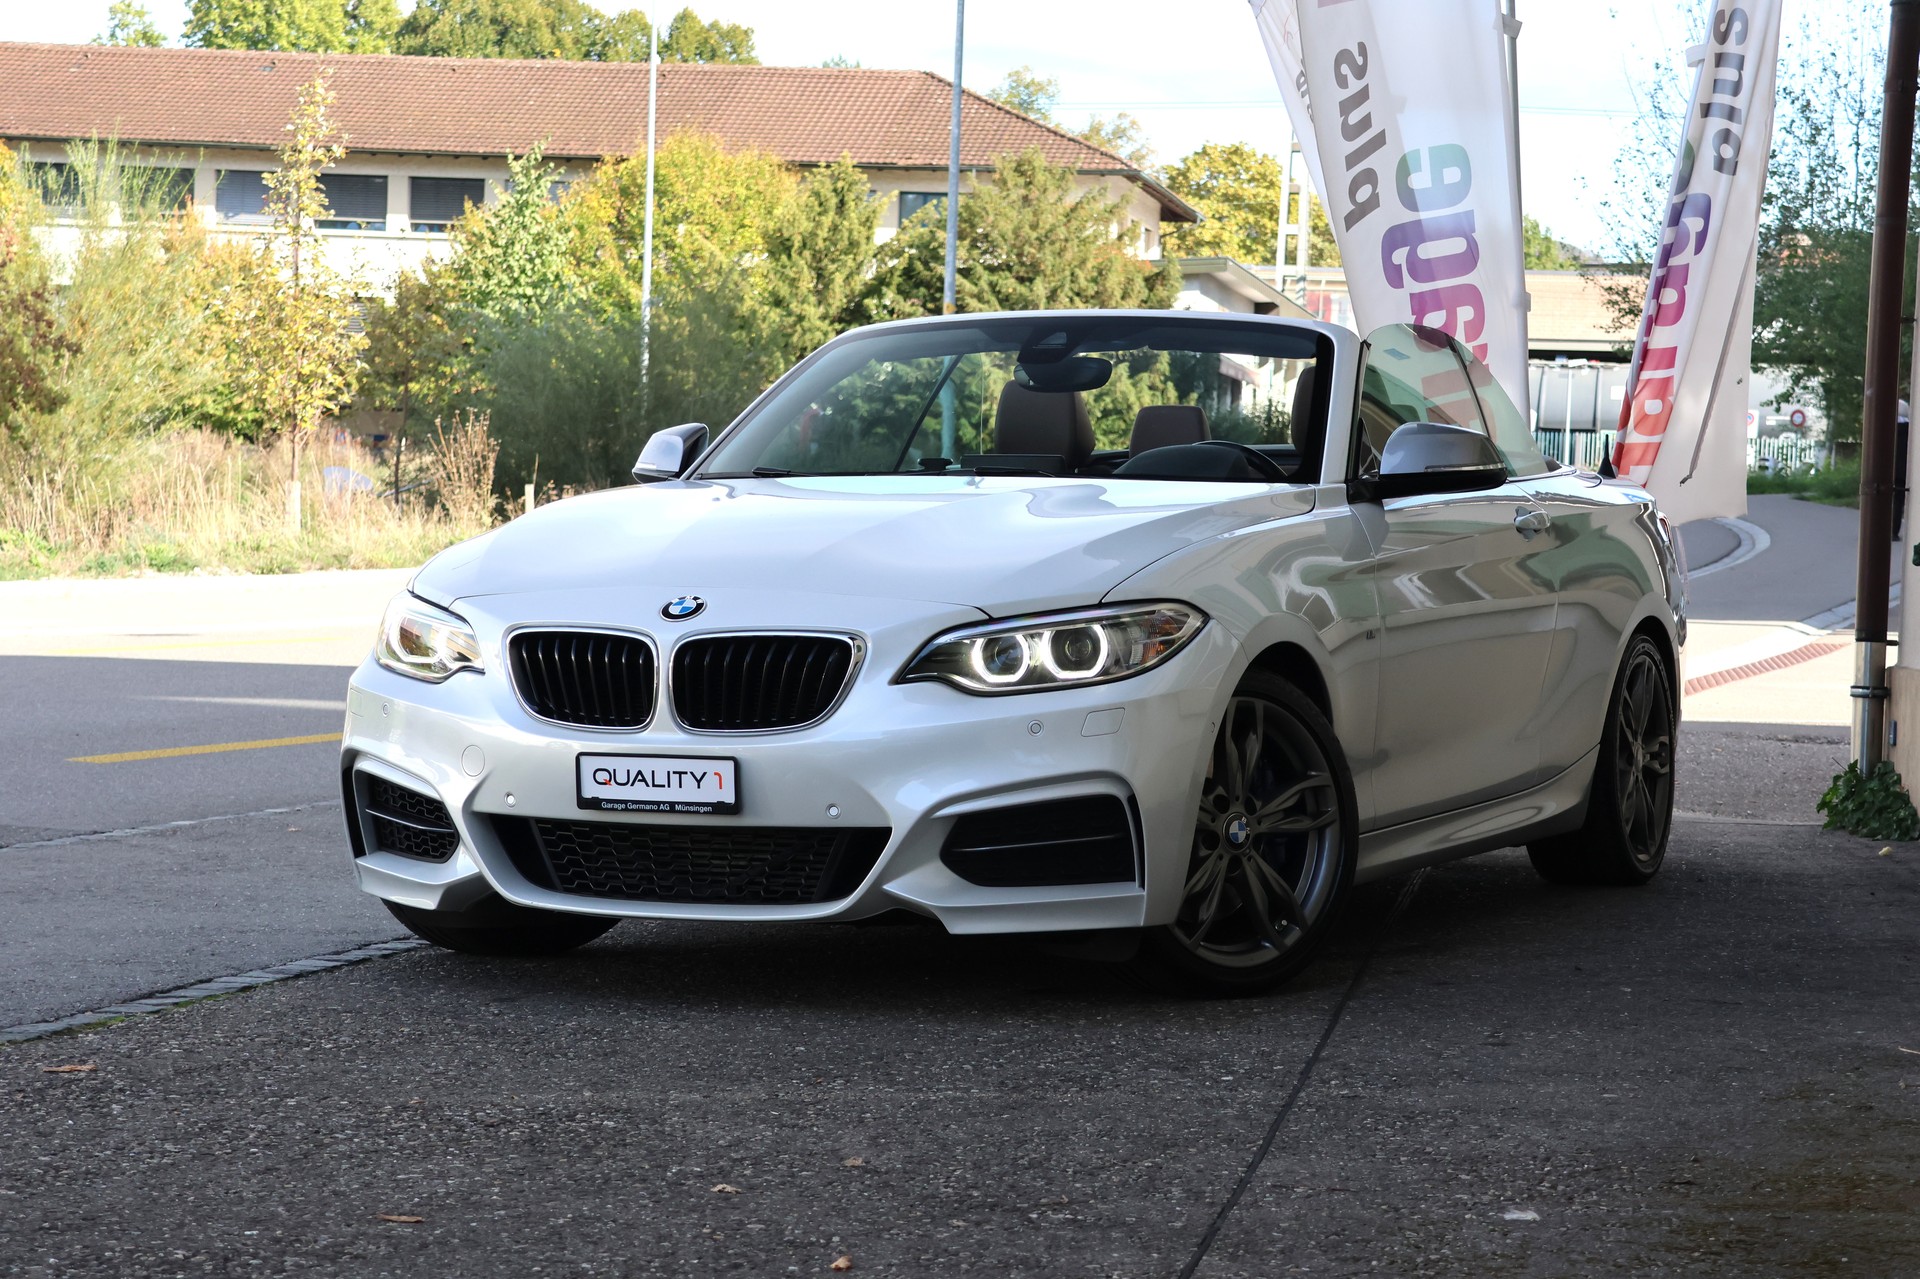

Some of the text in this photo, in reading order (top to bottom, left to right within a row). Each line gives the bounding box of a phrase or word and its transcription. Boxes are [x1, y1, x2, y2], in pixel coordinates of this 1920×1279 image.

[1699, 7, 1749, 177] plus
[592, 768, 707, 789] QUALITY
[601, 801, 713, 813] Garage Germano AG Münsingen
